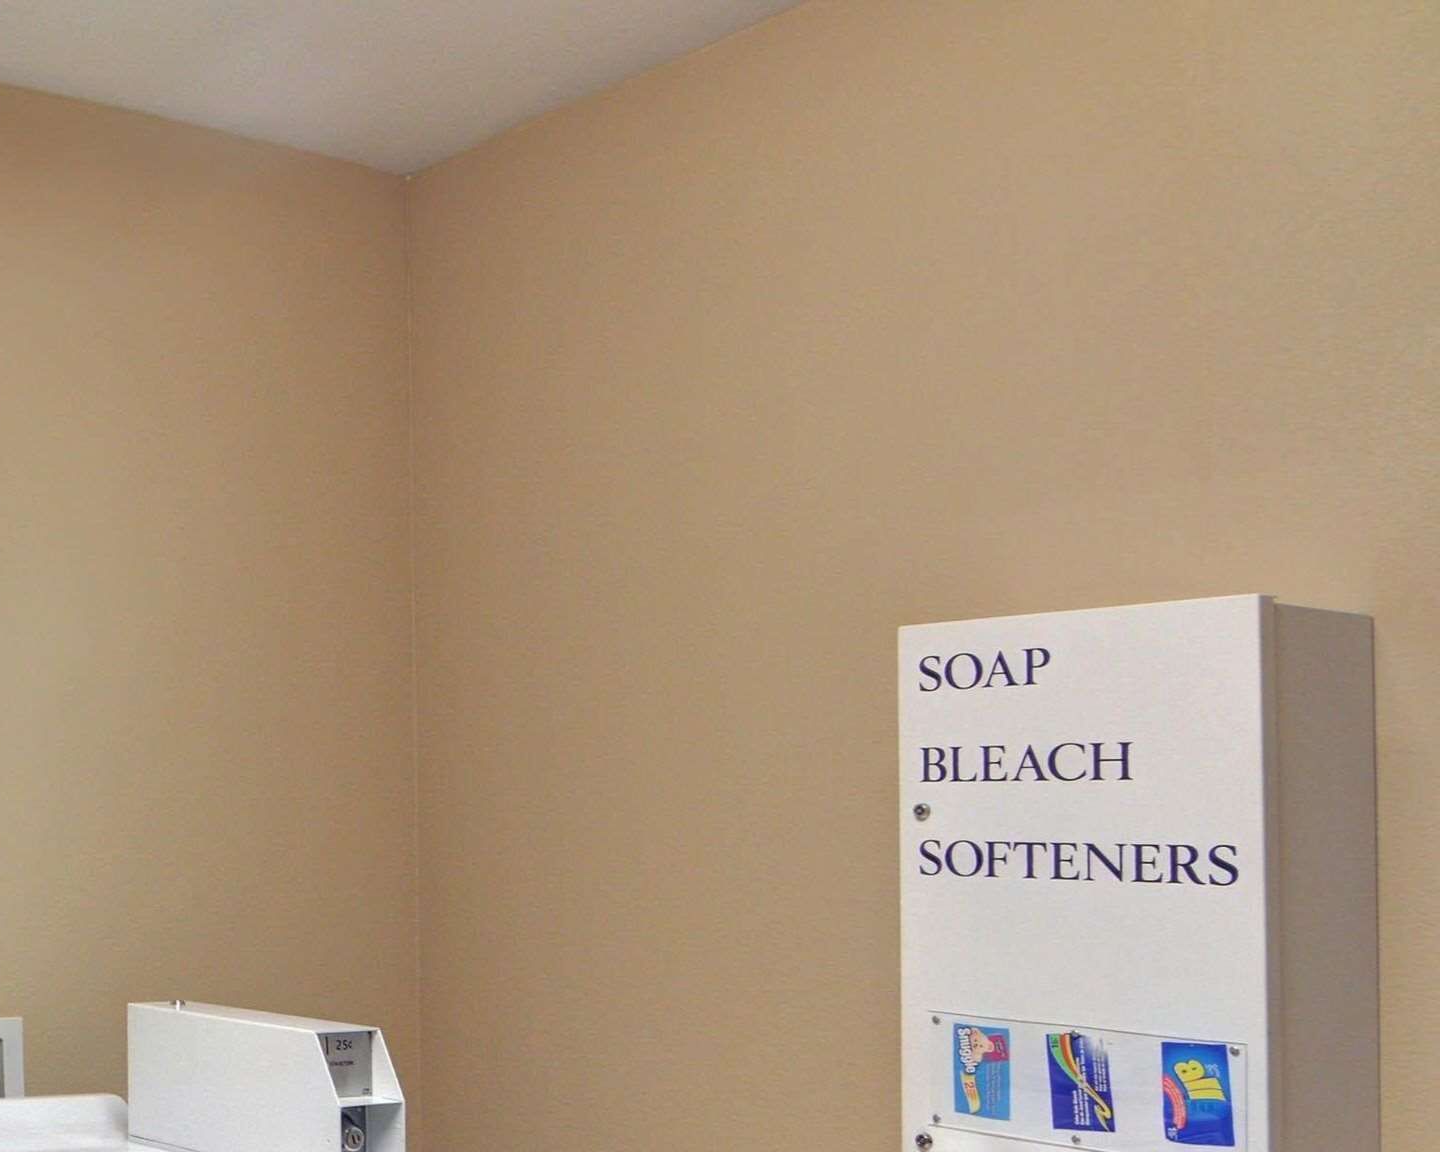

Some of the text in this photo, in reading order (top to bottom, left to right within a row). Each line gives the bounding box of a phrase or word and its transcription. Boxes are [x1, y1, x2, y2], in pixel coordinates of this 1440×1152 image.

[918, 646, 1051, 692] SOAP
[920, 741, 1134, 784] BLEACH
[918, 839, 1240, 887] SOFTENERS
[958, 1028, 978, 1073] Snuggle
